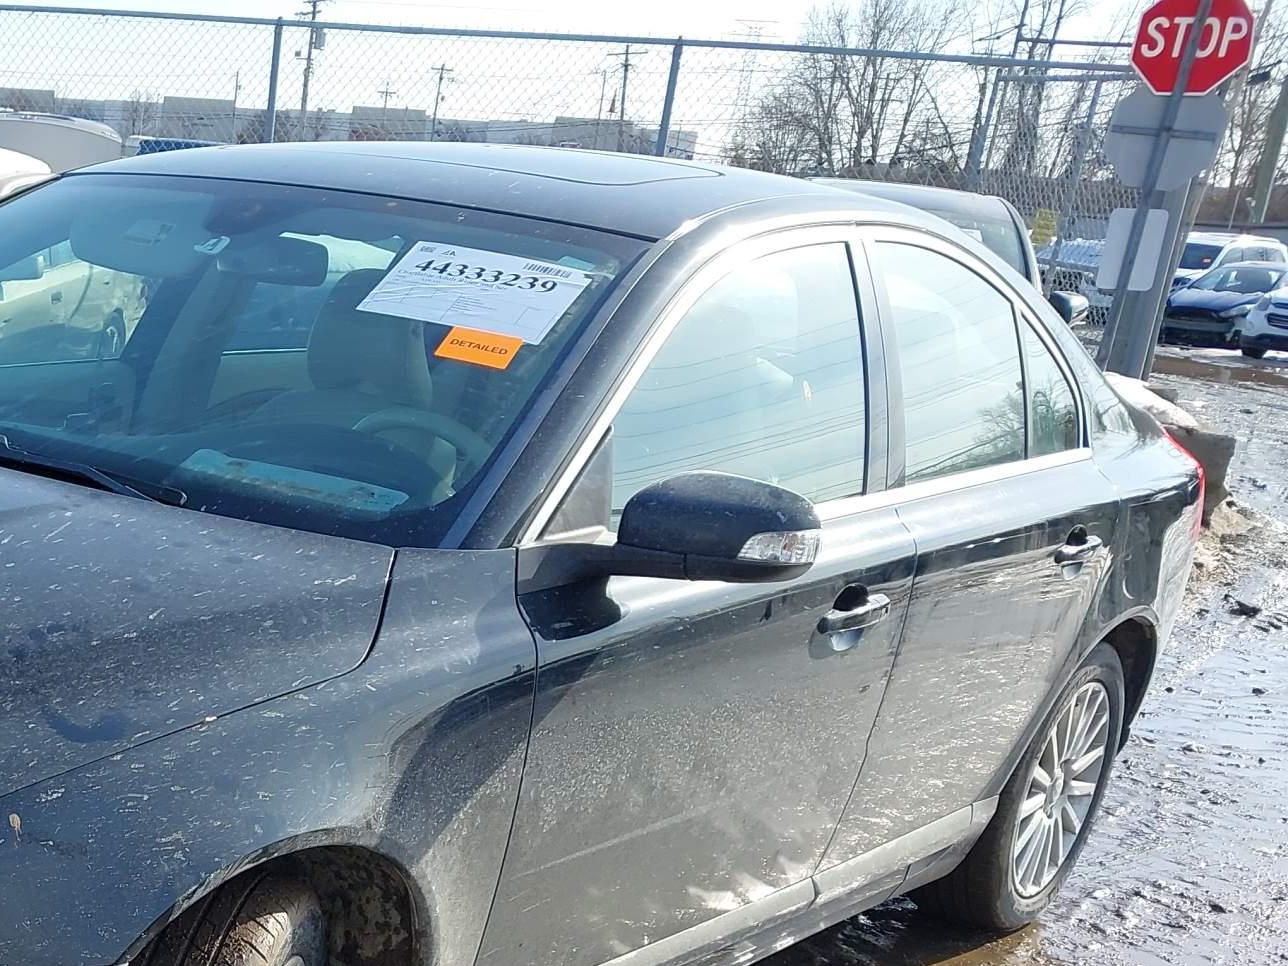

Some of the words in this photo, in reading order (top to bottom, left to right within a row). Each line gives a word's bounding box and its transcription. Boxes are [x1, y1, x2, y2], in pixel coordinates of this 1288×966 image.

[1140, 16, 1248, 58] STOP
[415, 259, 559, 293] 44333239
[449, 337, 509, 356] DETAILED
